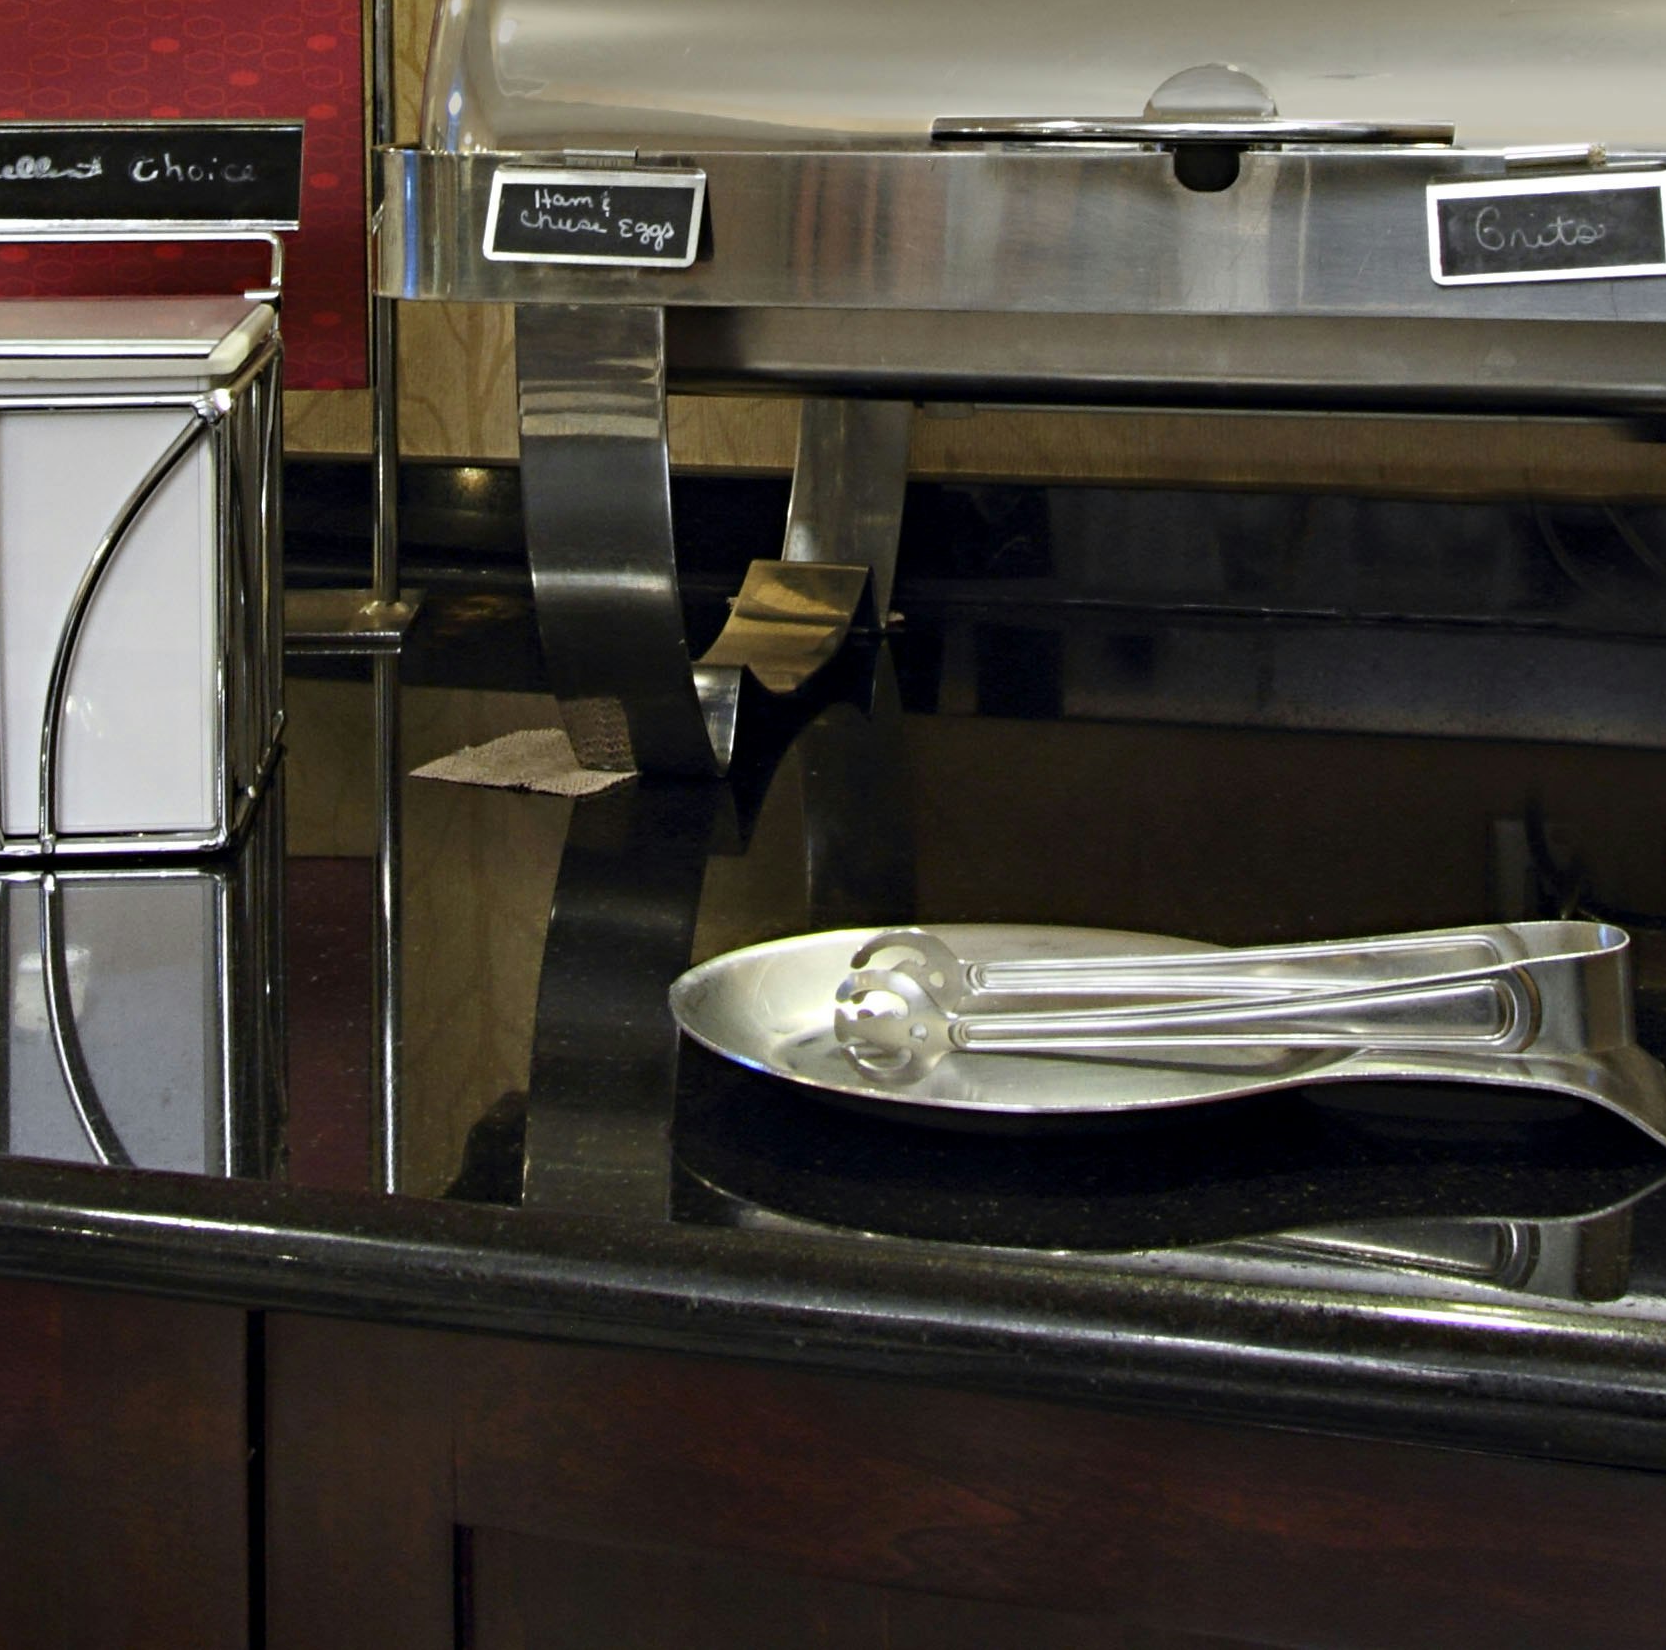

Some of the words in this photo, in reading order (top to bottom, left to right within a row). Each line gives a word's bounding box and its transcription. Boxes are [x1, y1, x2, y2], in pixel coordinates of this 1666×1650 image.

[534, 189, 594, 210] Ham
[618, 218, 675, 251] Eggs
[1475, 206, 1606, 251] Grits
